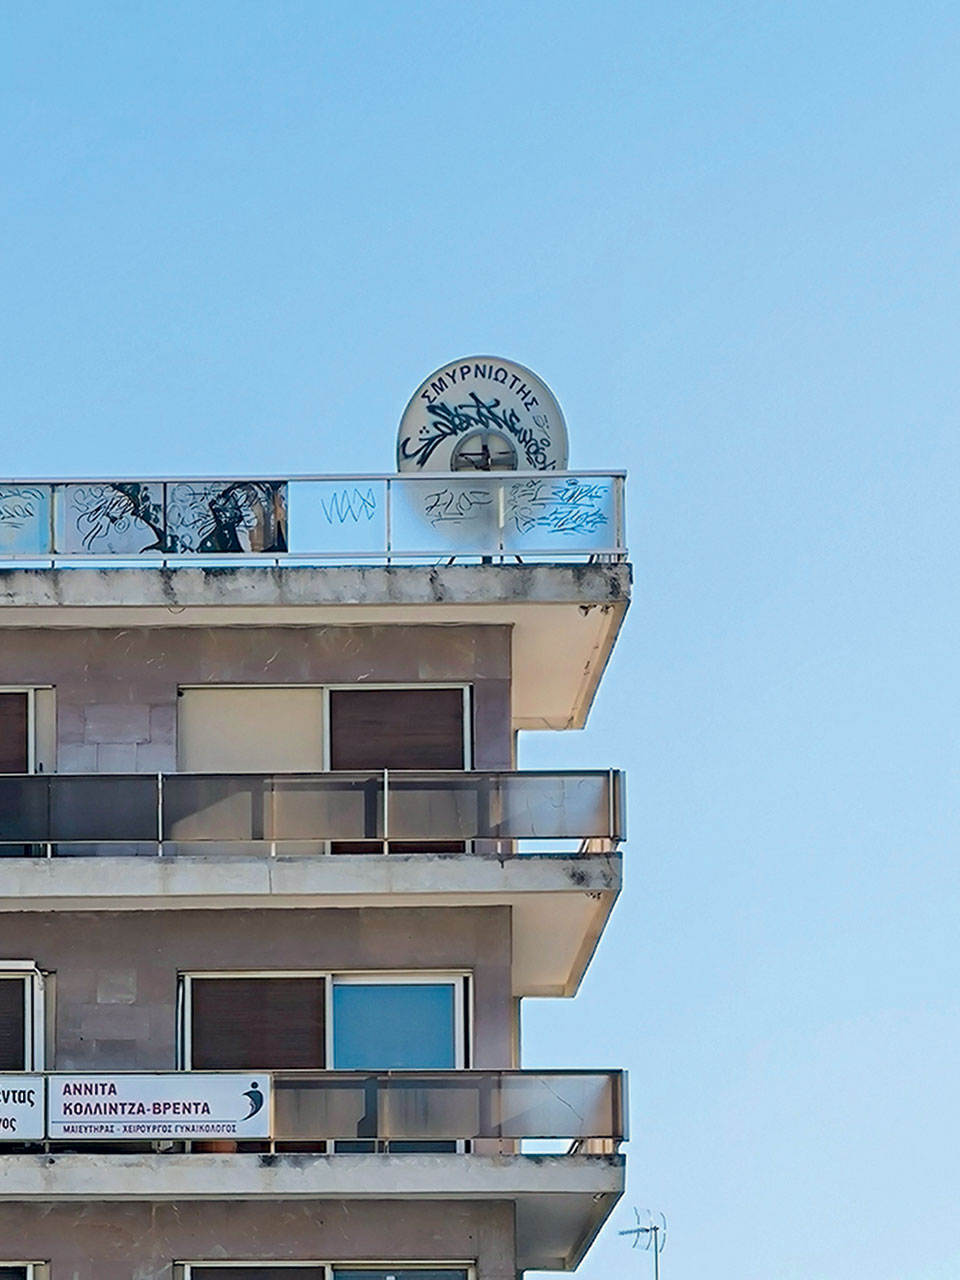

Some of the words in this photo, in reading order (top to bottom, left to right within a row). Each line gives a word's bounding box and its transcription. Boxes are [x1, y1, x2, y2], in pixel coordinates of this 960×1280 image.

[421, 364, 539, 412] ΣΜΥΡΝΙΩΤΗΣ
[62, 1083, 118, 1097] ΑΝΝΙΤΑ
[62, 1102, 212, 1116] ΚΟΛΛΙΝΤΖΑ-ΒΡΕΝΤΑ
[62, 1124, 114, 1134] ΜΑΙΕΥΤΗΡΑΣ
[122, 1124, 172, 1134] ΧΕΙΡΟΥΡΓΟΣ
[174, 1124, 237, 1134] ΓΥΝΑΙΚΟΛΟΓΟΣ
